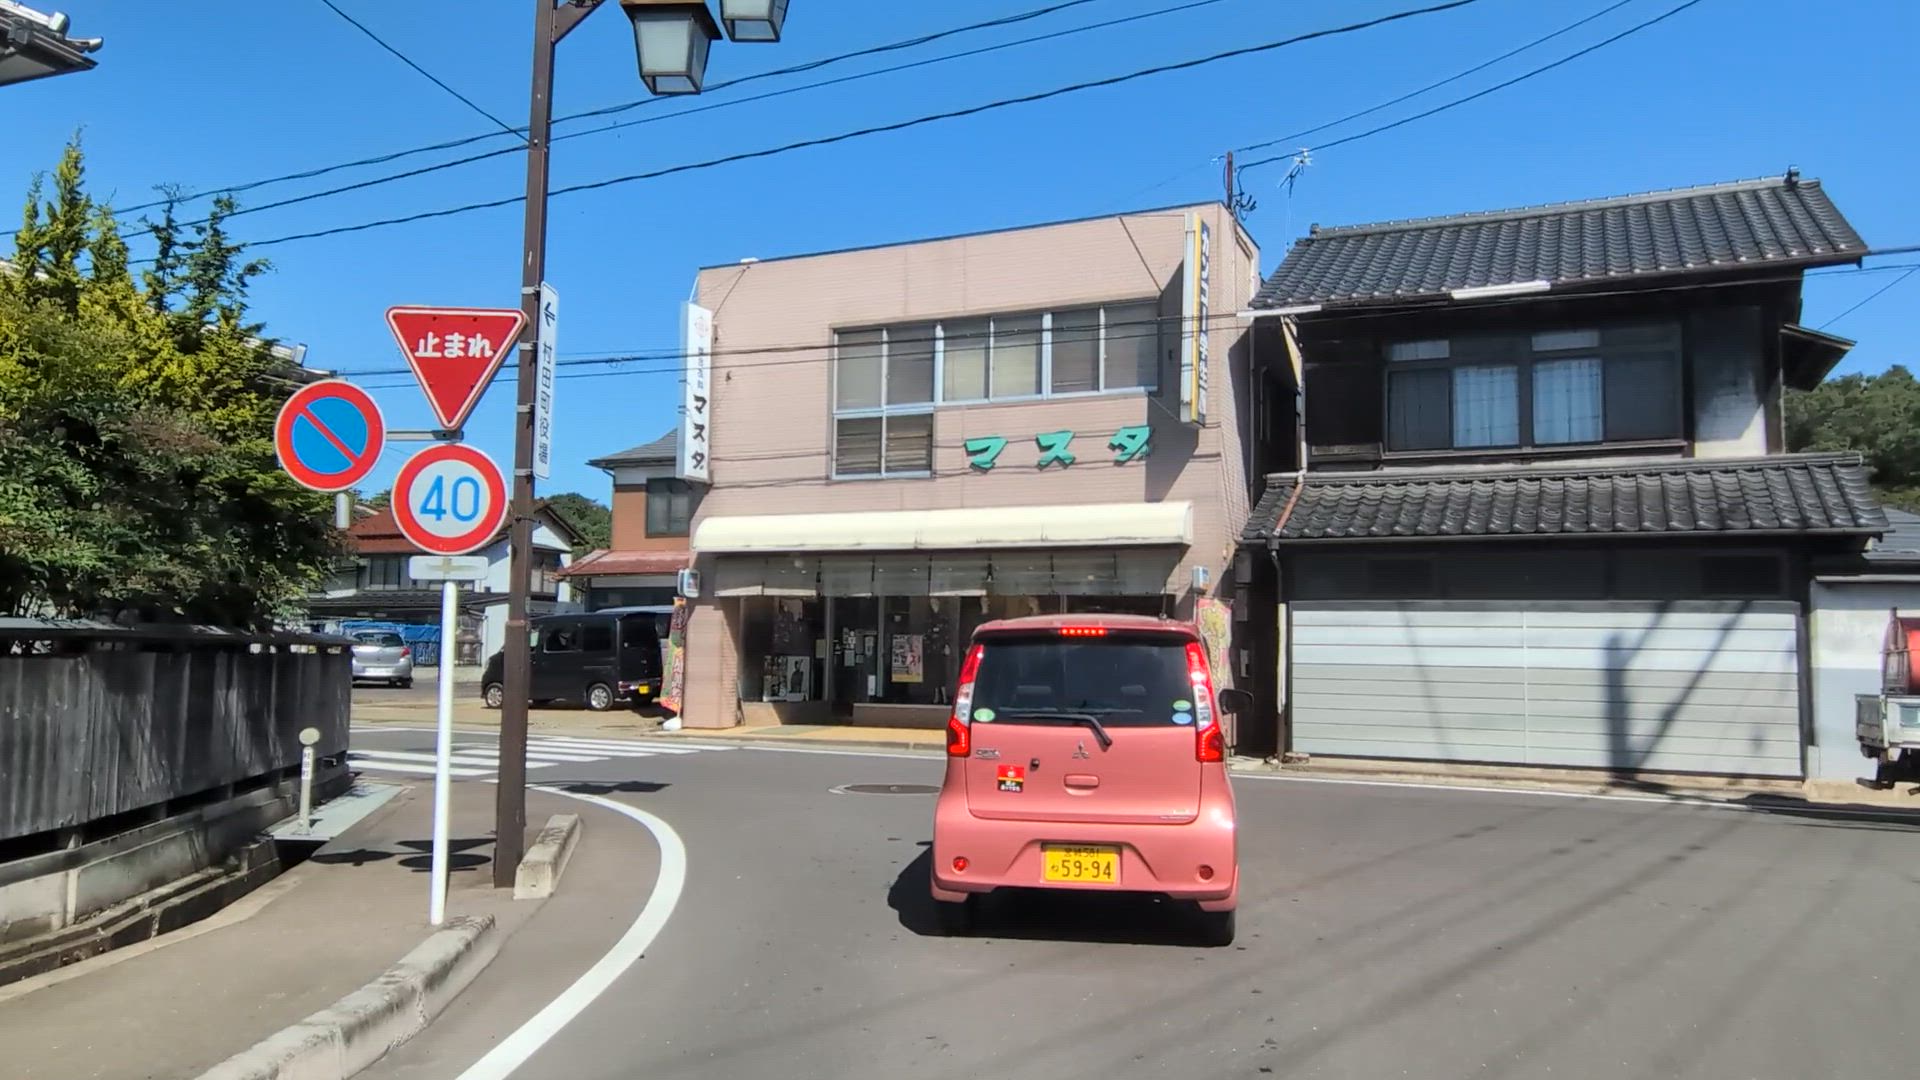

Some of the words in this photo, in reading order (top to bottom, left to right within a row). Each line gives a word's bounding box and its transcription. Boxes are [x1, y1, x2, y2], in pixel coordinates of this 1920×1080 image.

[414, 331, 494, 359] 止まれ
[691, 394, 708, 470] マスダ
[963, 425, 1153, 473] マスダ
[419, 475, 480, 522] 40
[1061, 859, 1112, 879] 59-94
